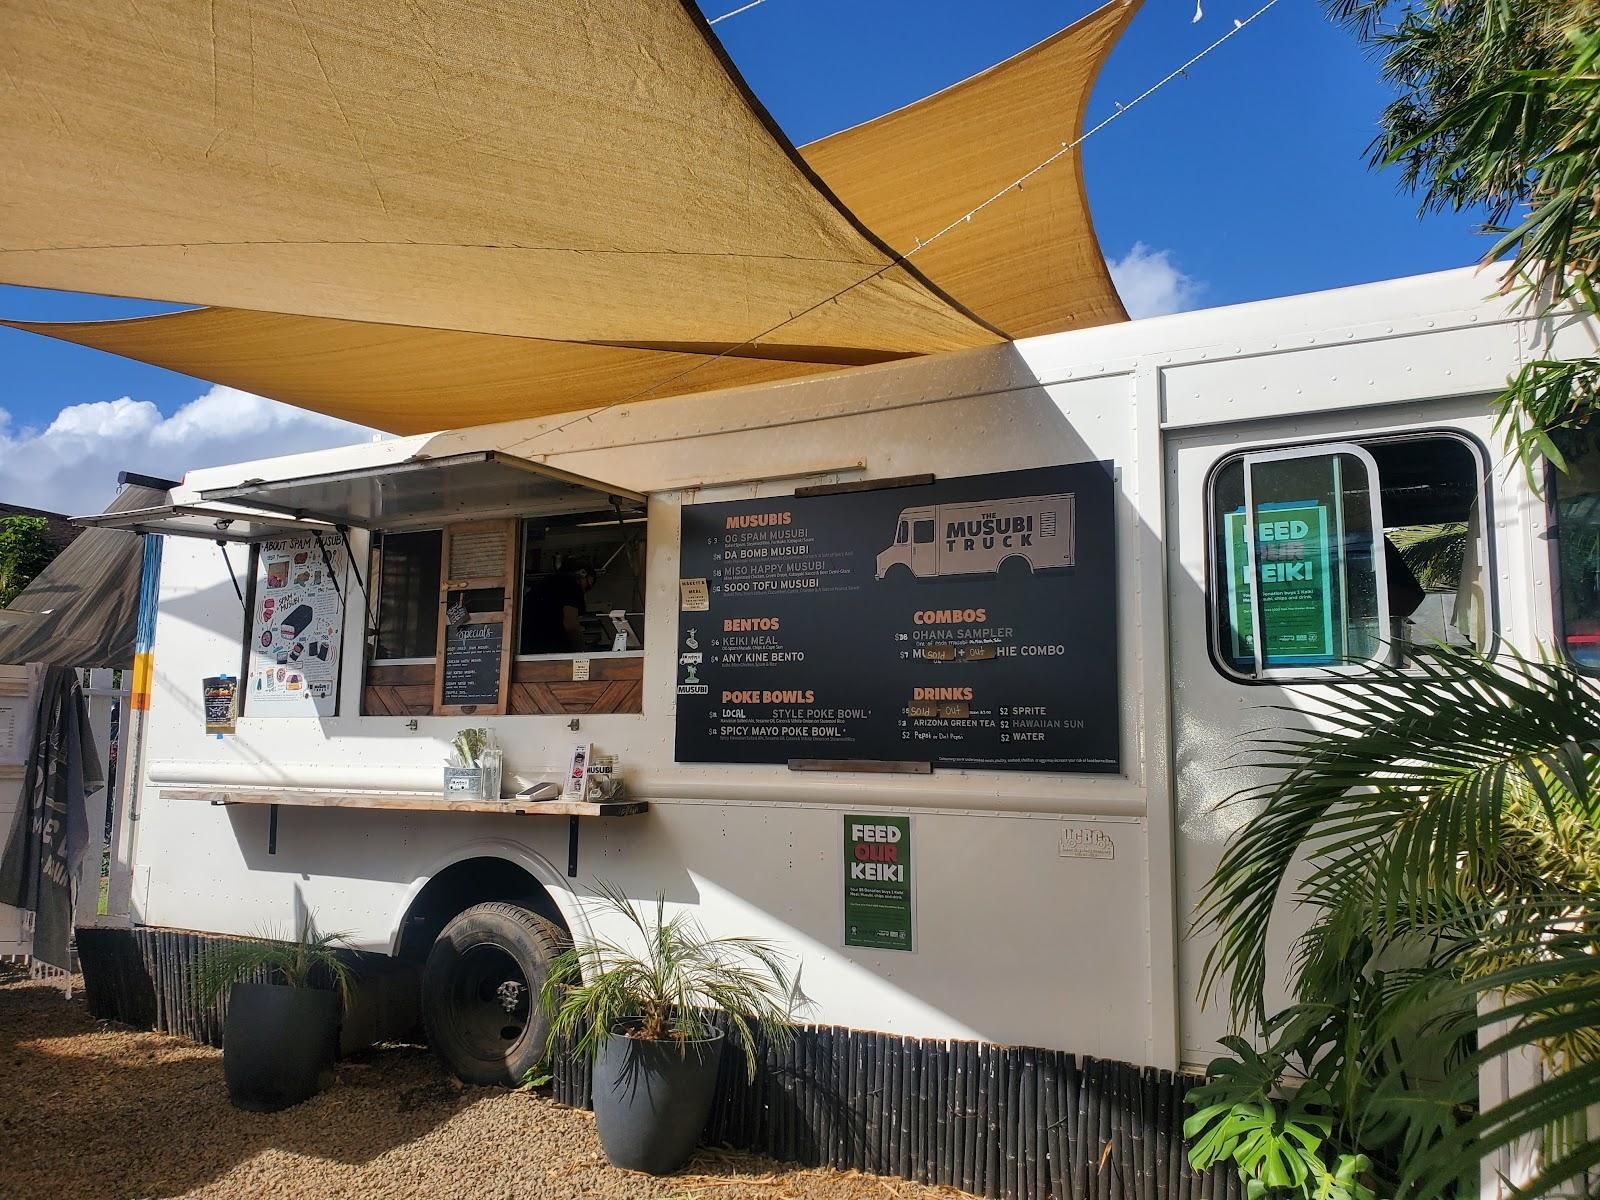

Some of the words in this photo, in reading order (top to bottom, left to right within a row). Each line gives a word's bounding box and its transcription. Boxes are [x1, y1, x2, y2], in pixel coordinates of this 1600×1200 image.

[726, 512, 791, 529] MUSUBIS
[946, 515, 1033, 538] MUSUBI
[724, 534, 738, 543] OG
[740, 532, 767, 541] SPAM
[770, 529, 808, 540] MUSUBI
[290, 537, 311, 550] SPAM
[946, 534, 1033, 552] TRUCK
[724, 551, 738, 560] DA
[740, 548, 768, 559] BOMB
[770, 545, 809, 556] MUSUBI
[724, 566, 748, 576] MISO
[750, 564, 783, 573] HAPPY
[787, 561, 825, 572] MUSUBI
[724, 582, 750, 592] SOOO
[752, 580, 778, 591] TOFU
[780, 578, 819, 589] MUSUBI
[913, 608, 986, 624] COMBOS
[723, 618, 780, 632] BENTOS
[722, 636, 748, 646] KEIKI
[751, 635, 778, 645] MEAL
[913, 630, 953, 641] OHANA
[957, 628, 1014, 639] SAMPLER
[722, 654, 743, 662] ANY
[745, 653, 769, 662] KINE
[771, 651, 805, 662] BENTO
[927, 651, 945, 660] Sold
[1020, 645, 1065, 656] COMBO
[678, 686, 707, 694] MUSUBI
[913, 688, 973, 700] DRINKS
[722, 690, 761, 704] POKE
[762, 690, 815, 704] BOWLS
[722, 708, 746, 718] LOCAL
[772, 709, 804, 719] STYLE
[806, 709, 835, 719] POKE
[911, 707, 930, 716] Sold
[1000, 707, 1009, 715] $2
[1012, 707, 1047, 715] SPRITE
[913, 719, 949, 727] ARIZONA
[951, 719, 978, 727] GREEN
[979, 719, 995, 727] TEA
[1000, 720, 1010, 729] $2
[1012, 719, 1060, 728] HAWAIIAN
[1063, 720, 1085, 729] SUN
[720, 726, 749, 736] SPICY
[751, 726, 779, 736] MAYO
[781, 726, 809, 736] POKE
[902, 731, 910, 739] $2
[1001, 734, 1010, 742] $2
[1012, 732, 1045, 741] WATER
[851, 824, 902, 843] FEED
[854, 844, 897, 862] OUR
[850, 862, 904, 882] KEIKI
